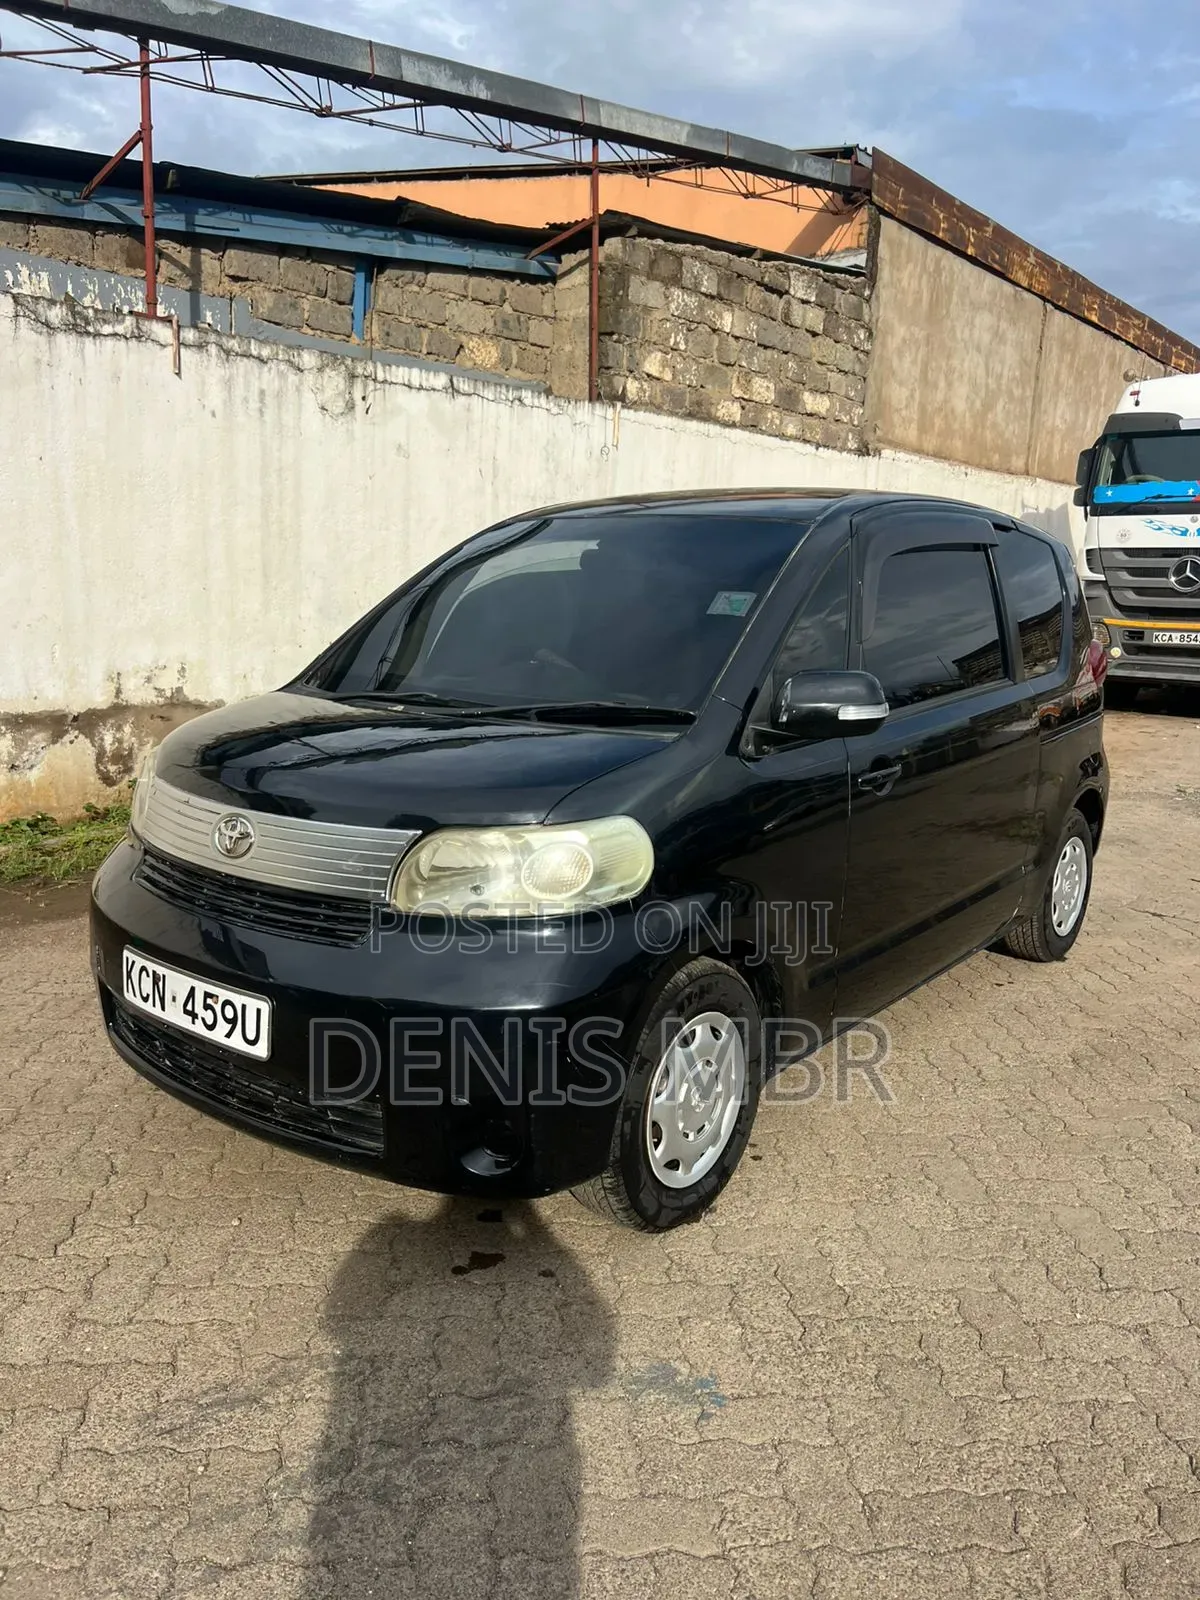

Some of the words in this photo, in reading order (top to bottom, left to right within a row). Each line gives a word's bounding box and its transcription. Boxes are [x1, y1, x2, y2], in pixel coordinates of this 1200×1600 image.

[1154, 633, 1173, 643] KCA
[1179, 634, 1200, 643] 854
[126, 956, 166, 1012] KCN
[183, 985, 261, 1047] 459U
